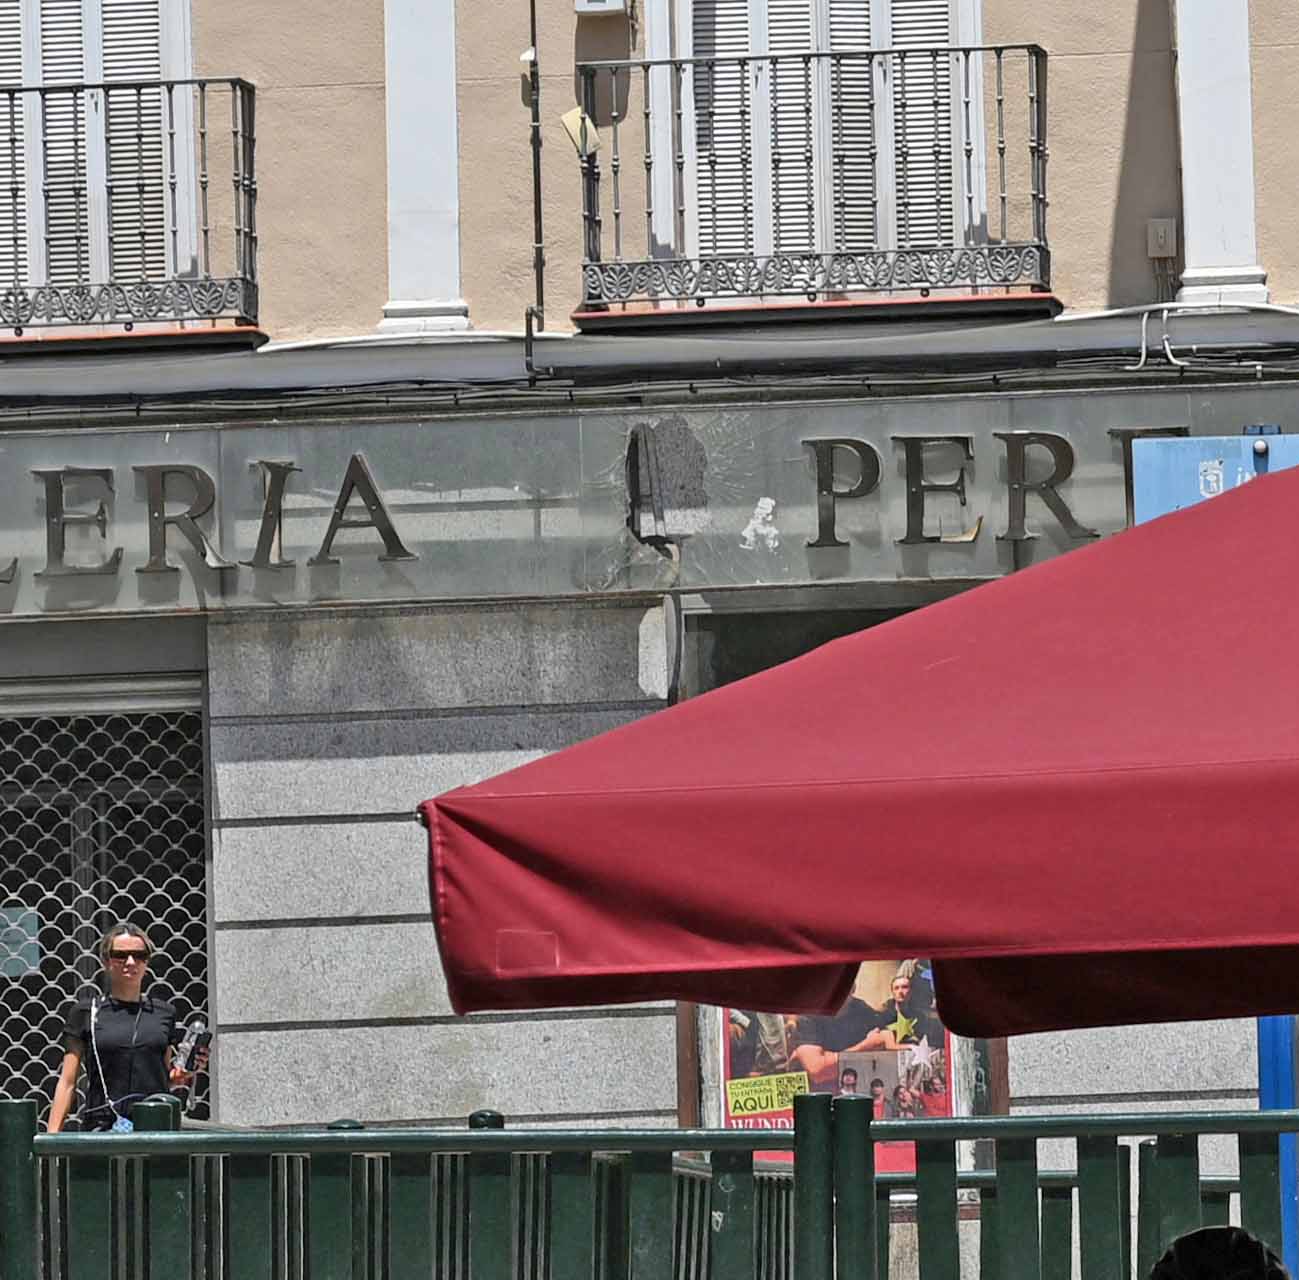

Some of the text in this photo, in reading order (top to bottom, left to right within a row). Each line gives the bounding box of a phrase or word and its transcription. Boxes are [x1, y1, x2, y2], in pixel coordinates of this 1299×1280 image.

[0, 453, 420, 583] ERIA
[732, 1095, 774, 1113] AQUI
[731, 1118, 794, 1129] WUND
